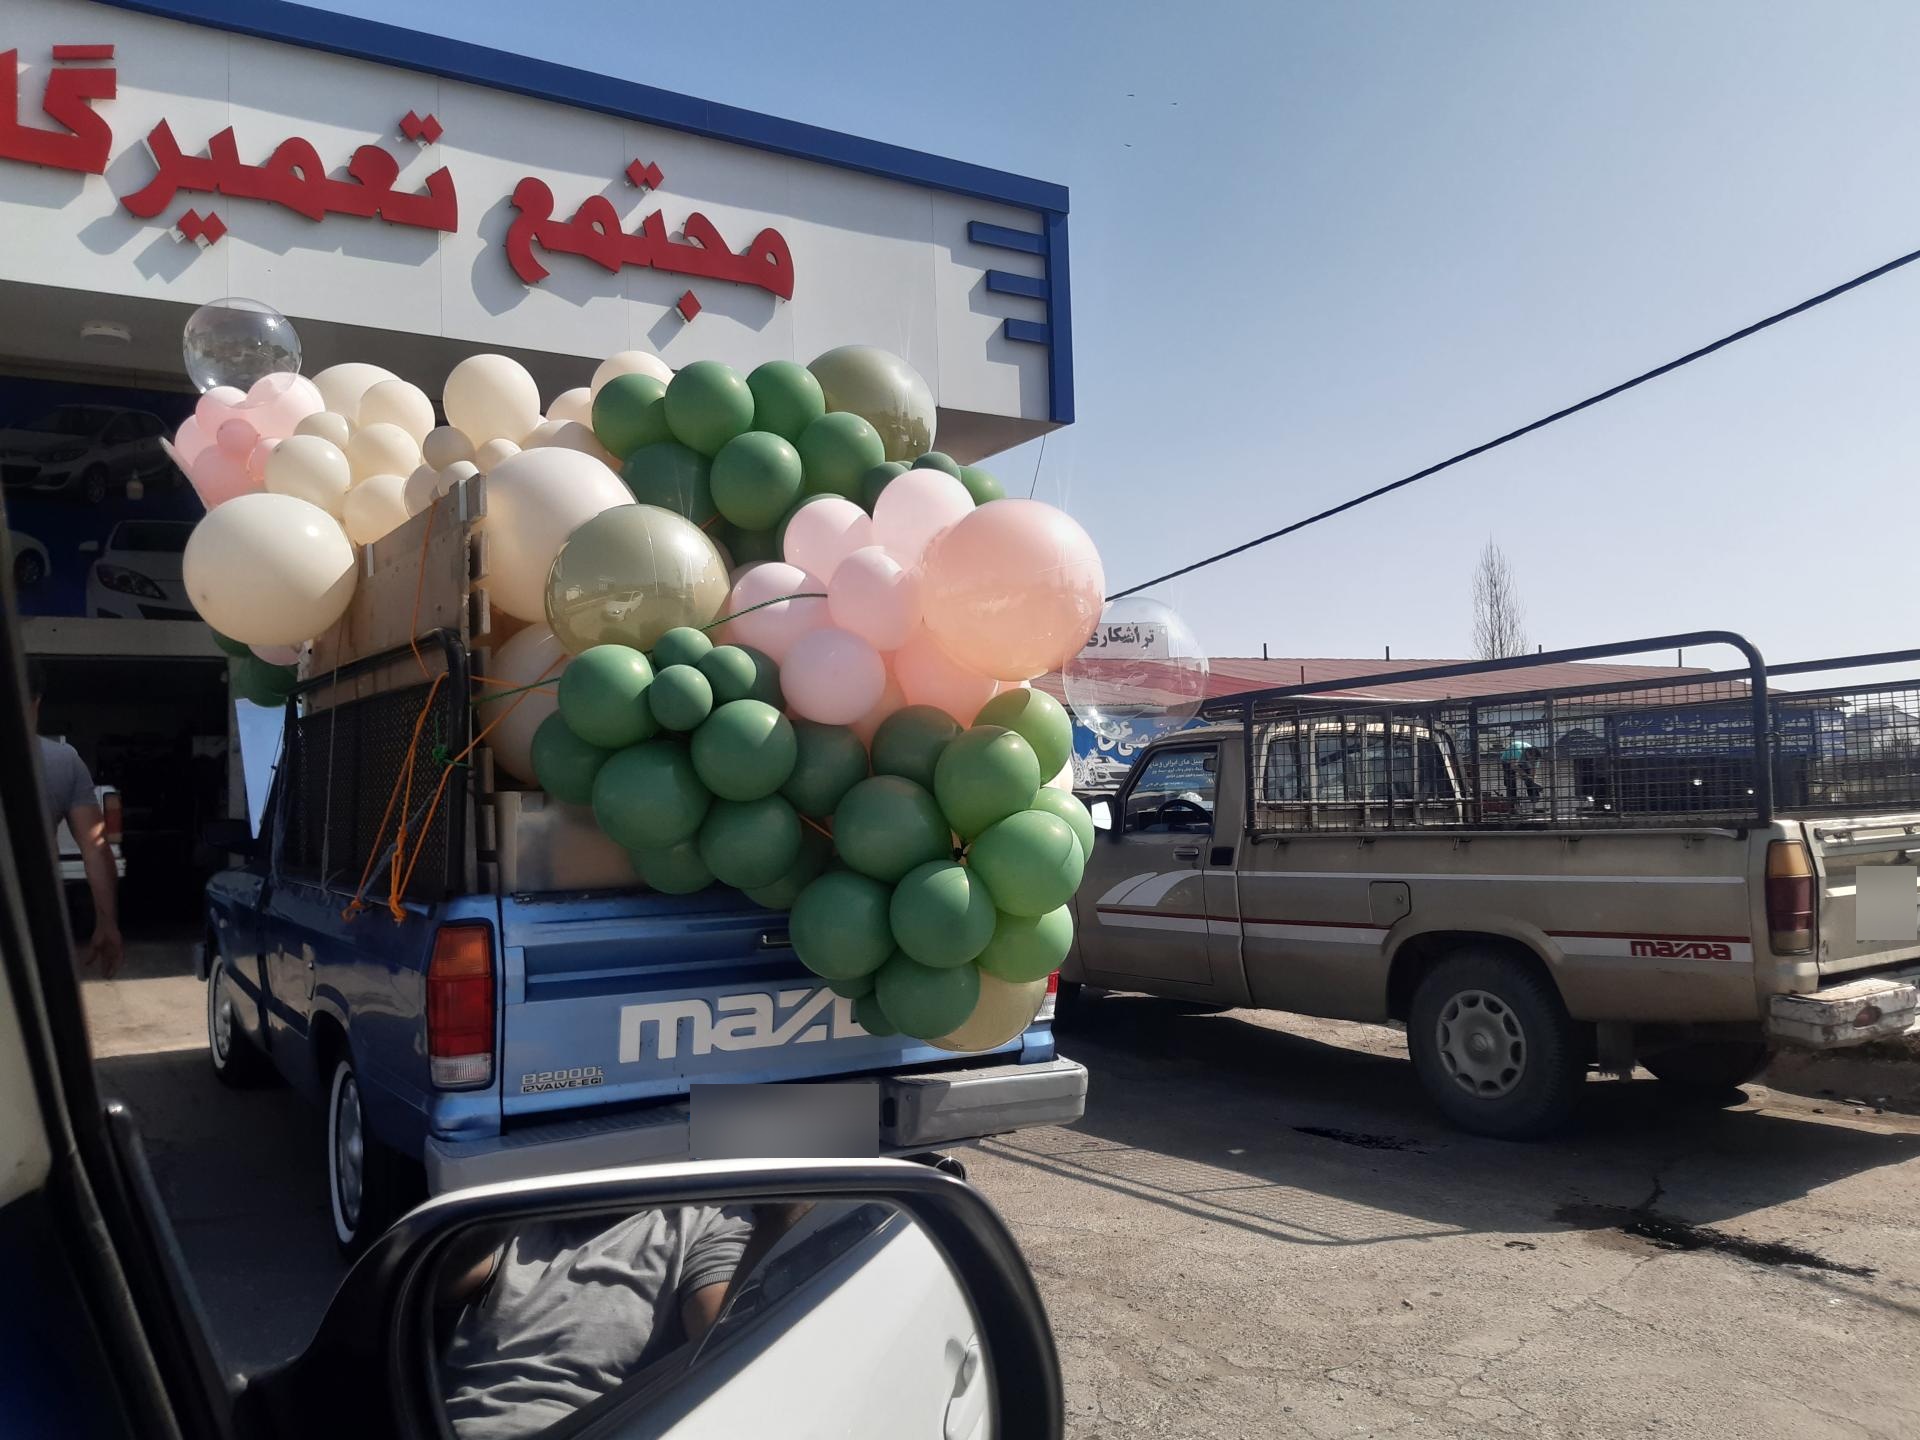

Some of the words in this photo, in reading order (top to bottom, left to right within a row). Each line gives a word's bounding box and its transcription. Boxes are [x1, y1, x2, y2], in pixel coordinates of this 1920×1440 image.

[505, 157, 795, 324] مجتمع
[619, 985, 871, 1064] maz
[522, 1066, 604, 1085] B2000i
